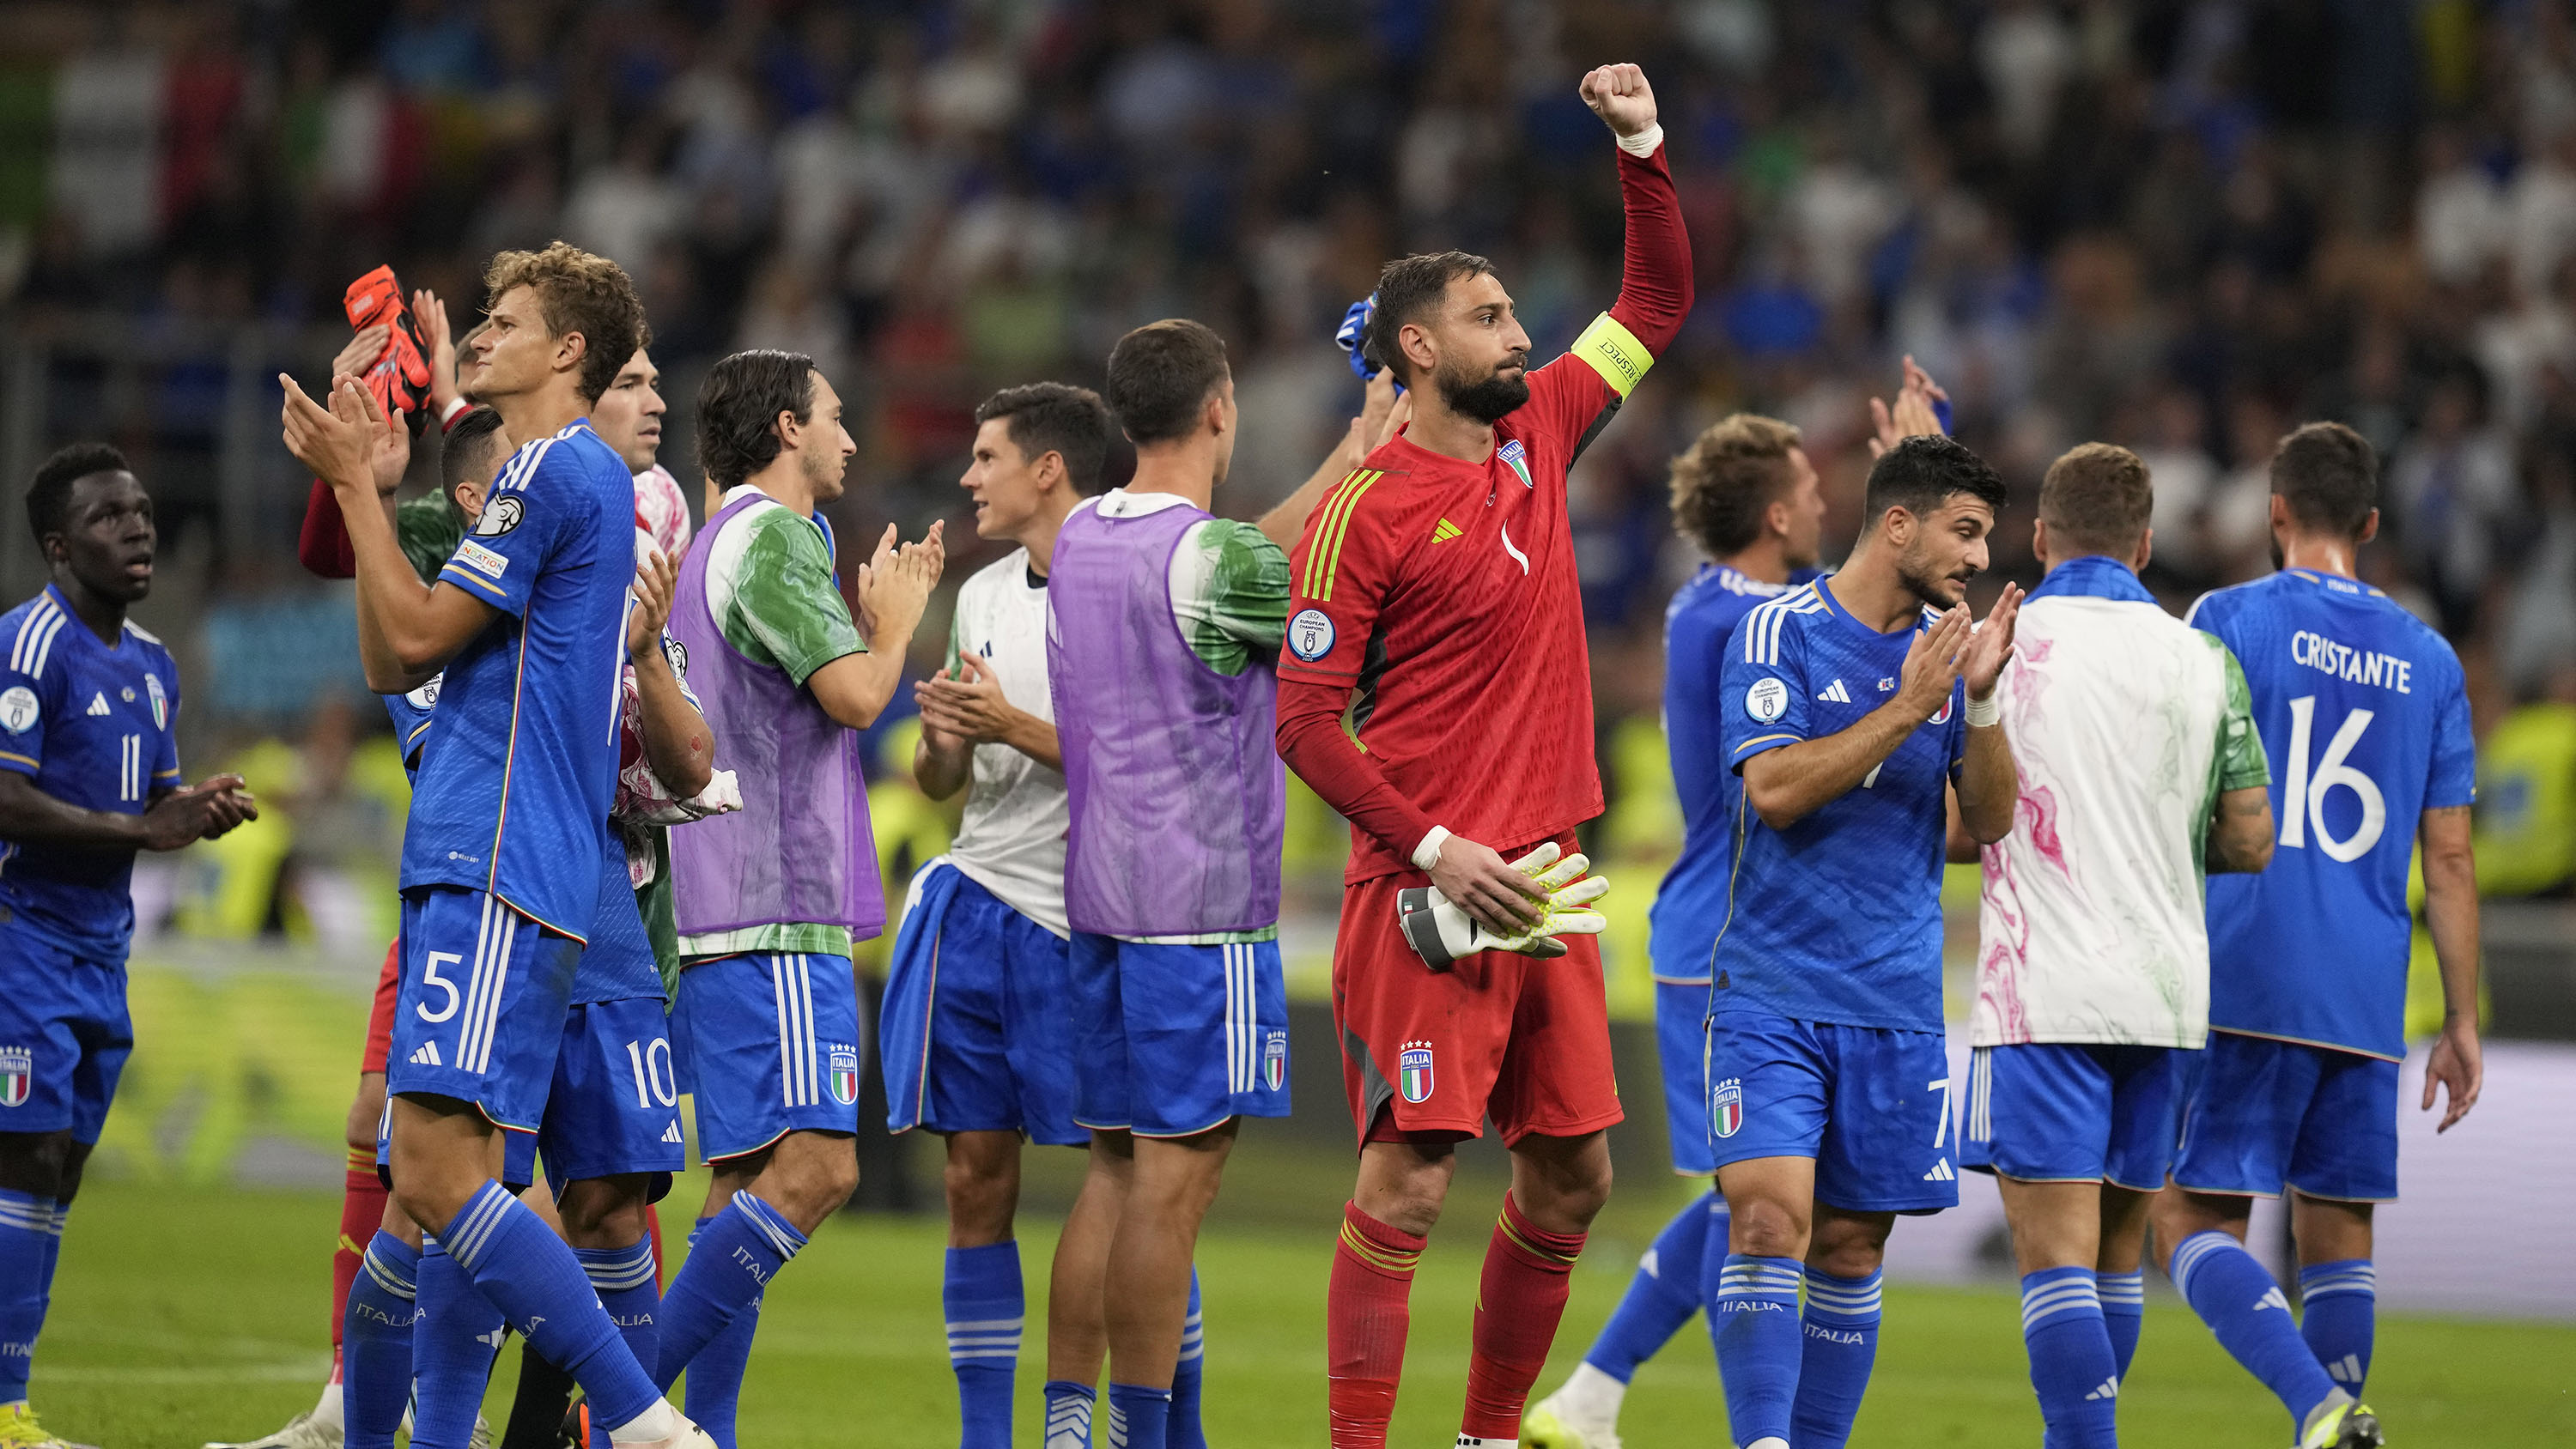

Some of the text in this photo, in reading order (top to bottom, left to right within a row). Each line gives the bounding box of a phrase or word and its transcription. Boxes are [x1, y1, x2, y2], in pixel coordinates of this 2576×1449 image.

[1599, 342, 1637, 379] RESPECT
[1500, 443, 1523, 460] ITALIA
[2291, 630, 2412, 694] CRISTANTE
[121, 734, 141, 801] 11
[2279, 695, 2386, 863] 16
[416, 950, 463, 1023] 5
[625, 1037, 677, 1108] 10
[832, 1057, 855, 1069] ITALIA
[1402, 1053, 1430, 1066] ITALIA
[1716, 1089, 1739, 1106] ITALIA
[1928, 1077, 1950, 1149] 7
[1805, 1323, 1864, 1345] ITALIA
